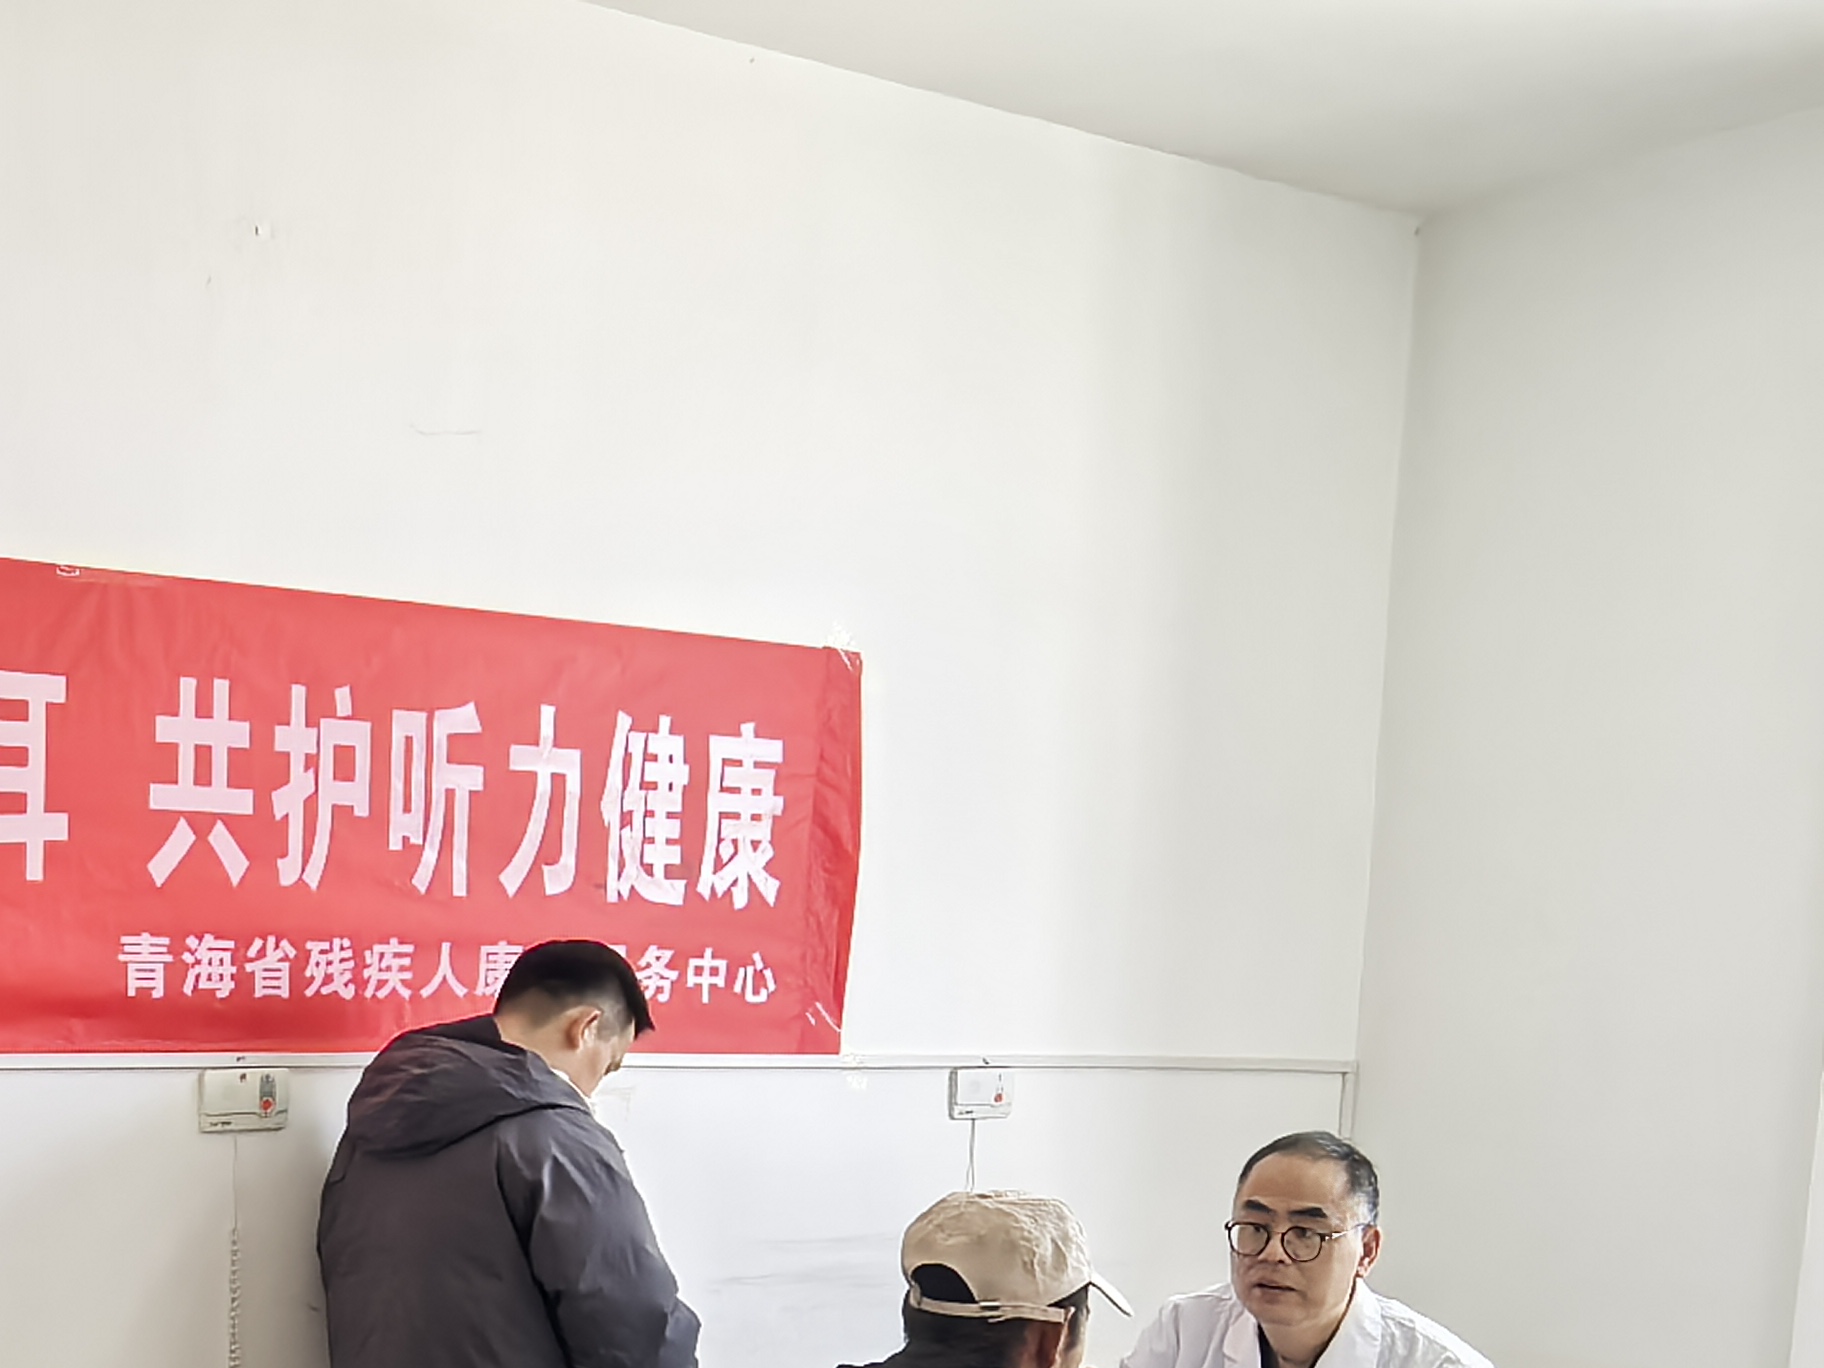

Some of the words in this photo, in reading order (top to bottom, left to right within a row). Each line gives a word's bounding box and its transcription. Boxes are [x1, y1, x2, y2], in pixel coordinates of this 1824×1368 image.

[146, 676, 784, 910] 共护听力健康
[117, 932, 777, 1003] 青海省残疾人康务中心
